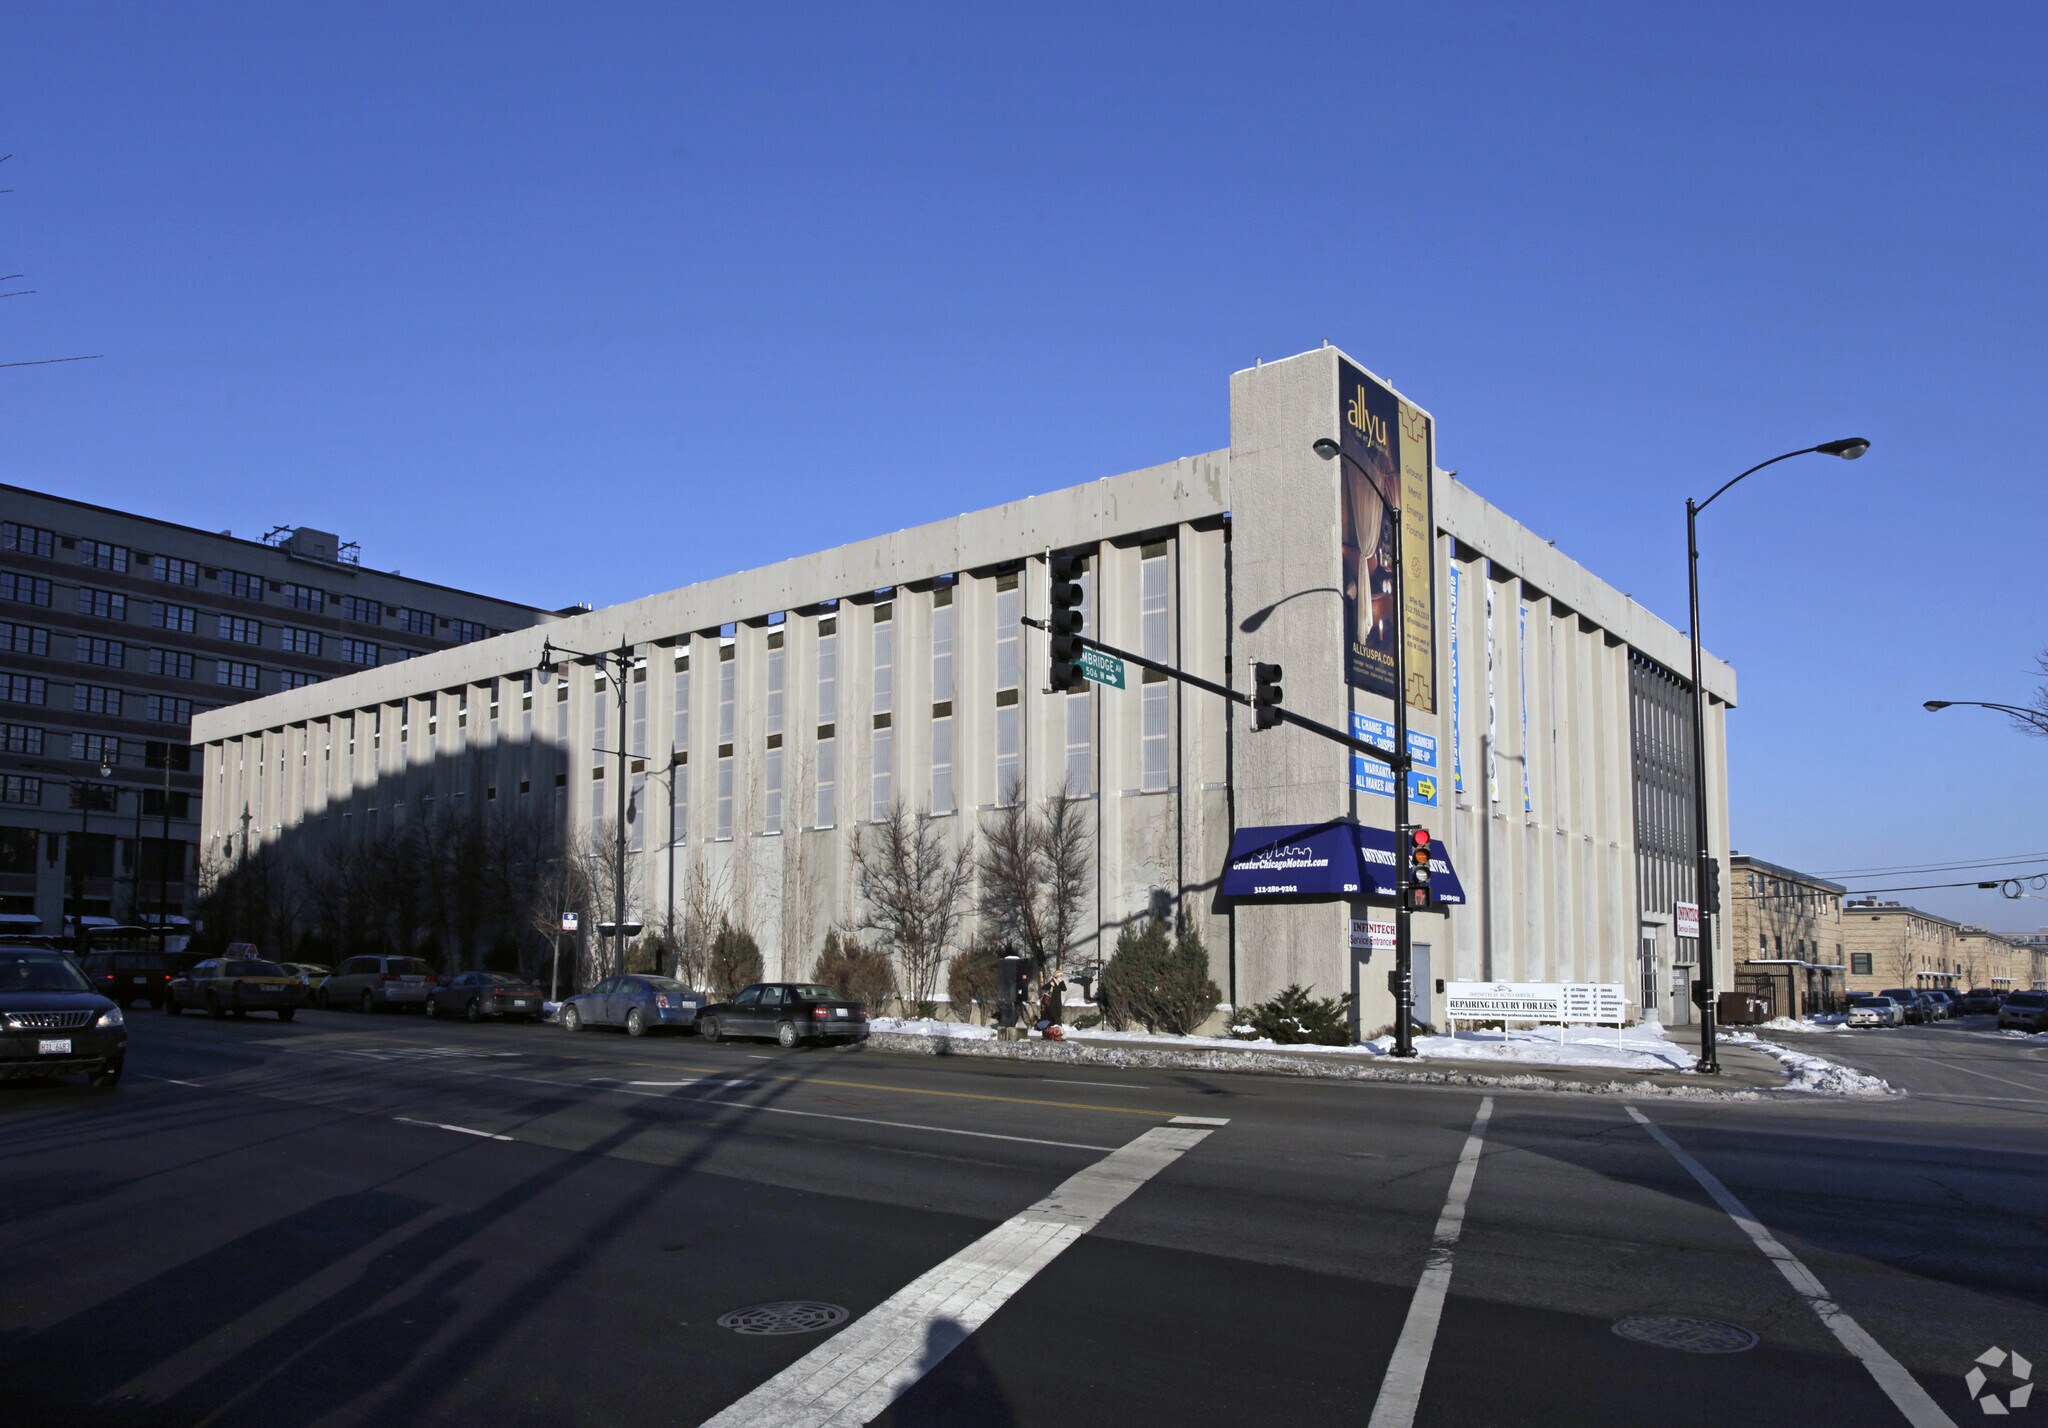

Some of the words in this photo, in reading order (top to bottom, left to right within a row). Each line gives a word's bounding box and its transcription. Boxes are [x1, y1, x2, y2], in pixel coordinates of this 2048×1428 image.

[1348, 384, 1386, 447] allyu
[1405, 464, 1423, 482] Ground
[1406, 503, 1424, 522] Emerge
[1406, 523, 1425, 541] Flourish
[1080, 651, 1115, 673] MBRIDGE
[1086, 666, 1098, 678] 506
[1100, 671, 1105, 680] W
[1361, 719, 1382, 735] CHANGE
[1386, 725, 1395, 739] BRA
[1408, 733, 1434, 750] ALIGNMENT
[1377, 737, 1395, 753] SUSPE
[1411, 747, 1430, 762] TUNE-UP
[1363, 761, 1391, 780] WARRANTY
[1356, 774, 1365, 787] ALL
[1365, 776, 1384, 792] MAKES
[1233, 859, 1328, 870] GreaterChicagoMotors.com
[1254, 885, 1297, 894] 312-280-9262
[1343, 884, 1358, 892] 530
[1353, 922, 1395, 934] INFINITECH
[1350, 934, 1369, 945] Service
[1370, 936, 1392, 946] Entrance
[1450, 1000, 1490, 1008] REPAIRING
[1491, 1001, 1520, 1009] LUXURY
[1522, 1002, 1538, 1010] FOR
[1539, 1002, 1558, 1010] LESS
